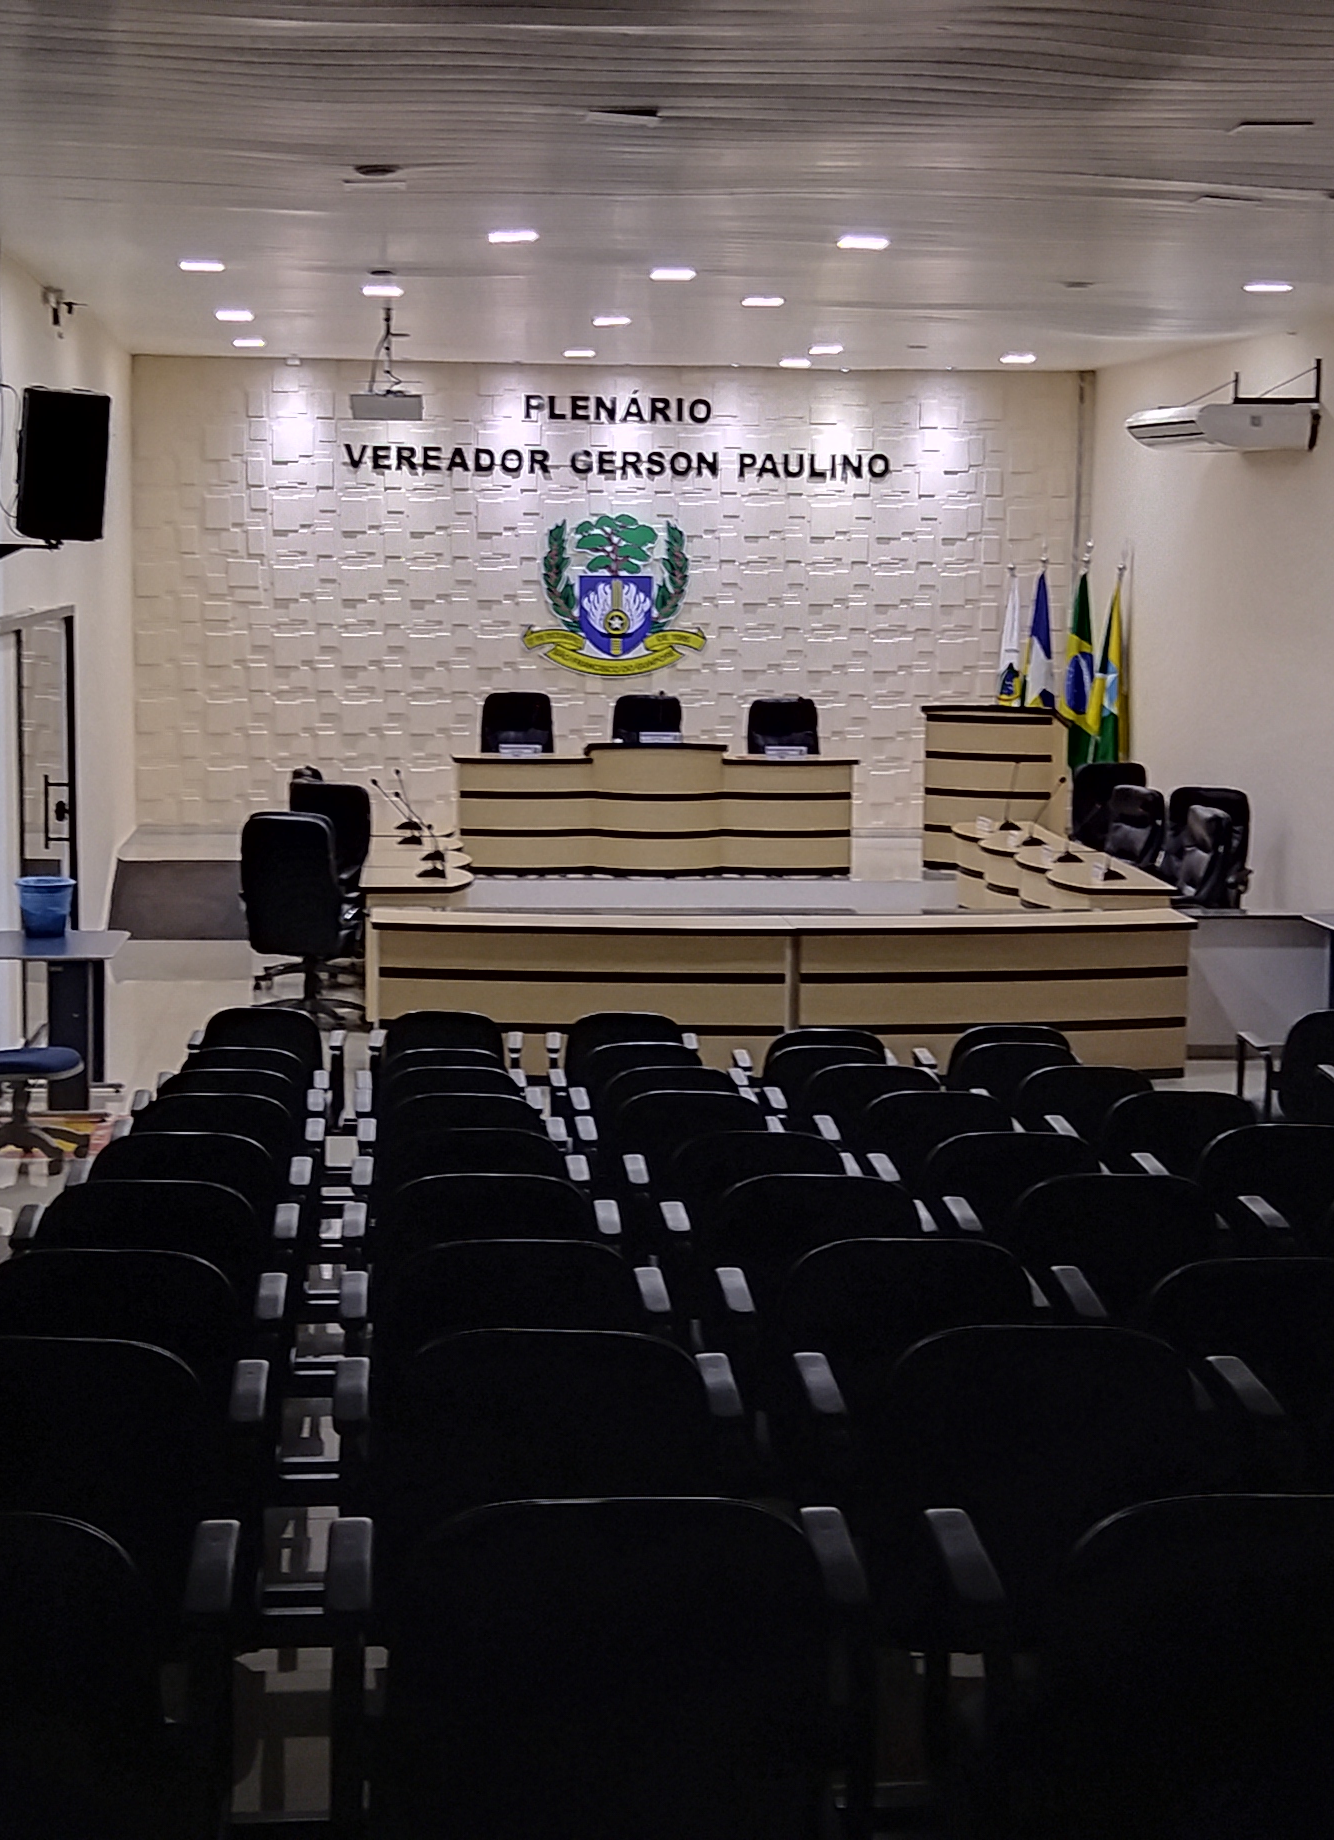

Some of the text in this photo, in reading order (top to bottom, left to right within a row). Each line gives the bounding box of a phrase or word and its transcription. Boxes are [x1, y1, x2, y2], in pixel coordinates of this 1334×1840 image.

[524, 390, 712, 423] PLENÁRIO
[344, 443, 890, 478] VEREADOR GERSON PAULINO
